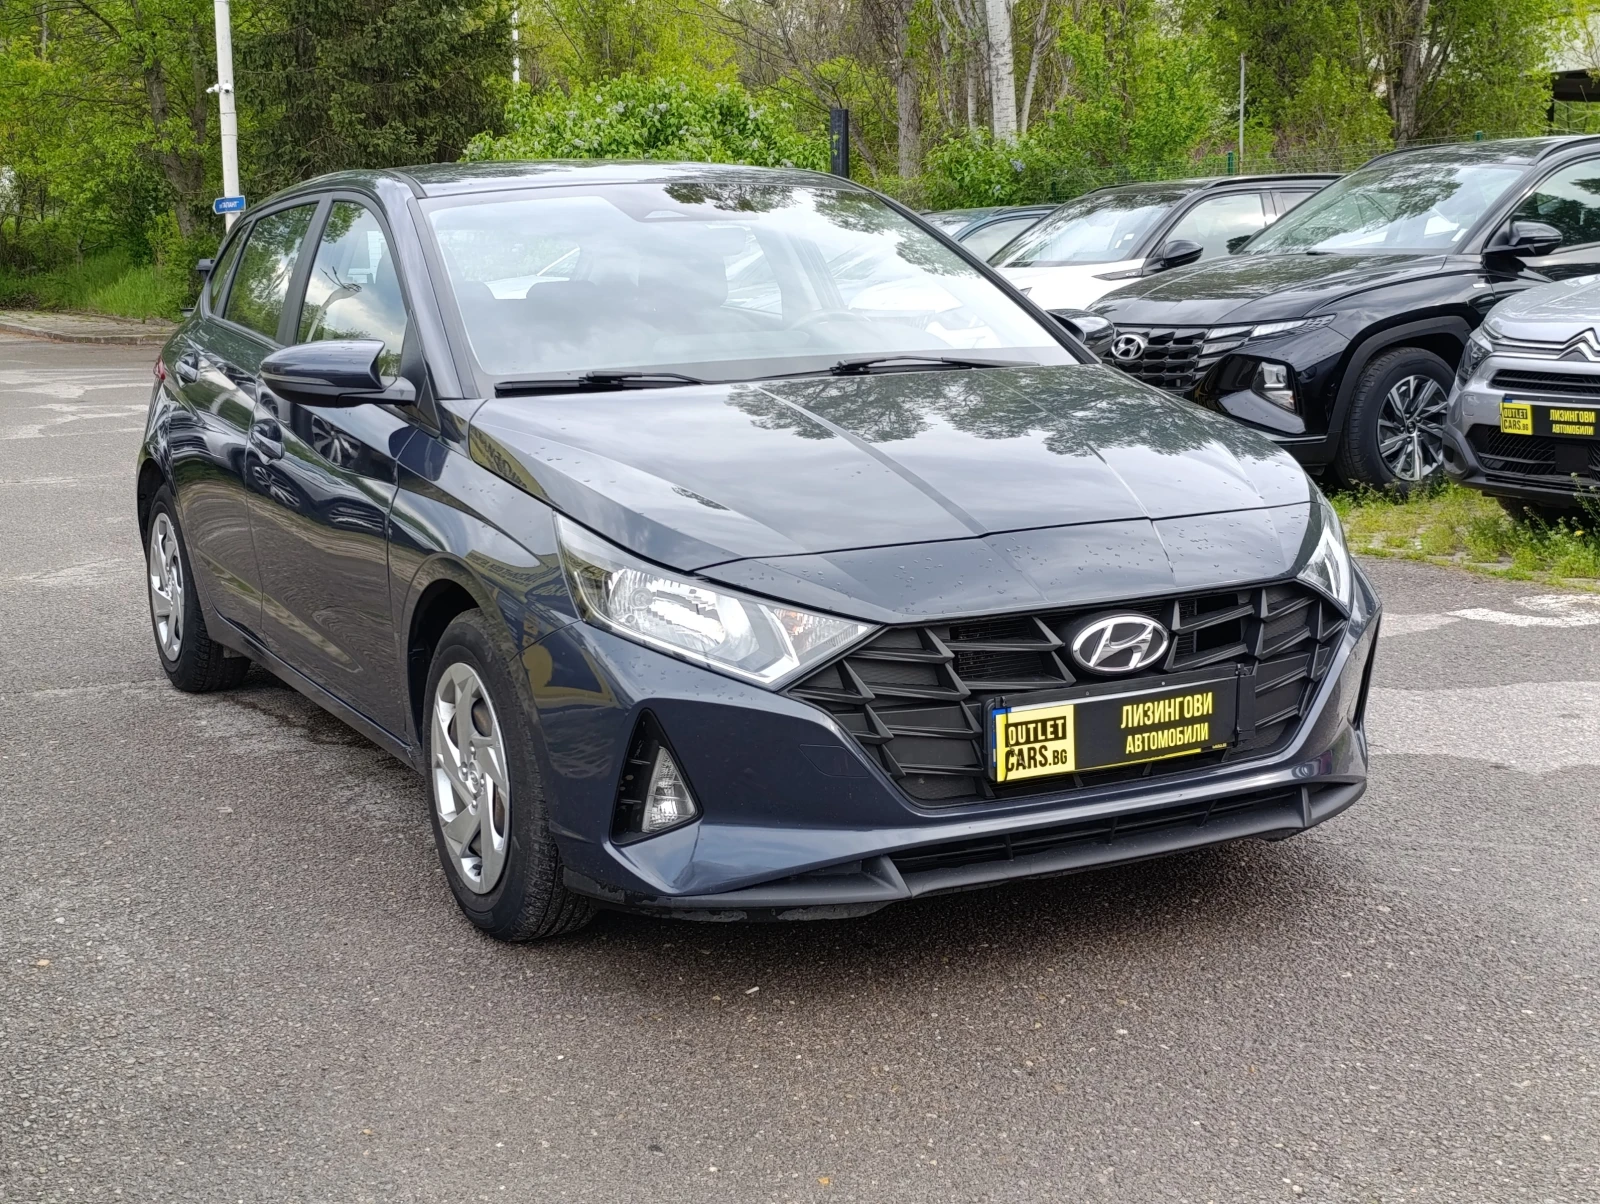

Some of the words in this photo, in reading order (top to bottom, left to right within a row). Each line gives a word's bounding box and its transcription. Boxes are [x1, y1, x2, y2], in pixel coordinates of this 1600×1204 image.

[1503, 408, 1527, 419] OUTLET
[1549, 409, 1596, 423] ЛИЗИНГОВИ
[1552, 423, 1594, 436] АВТОМОБИЛИ
[1120, 691, 1213, 729] ЛИЗИНГОВИ
[1008, 719, 1065, 745] OUTLET
[1125, 722, 1209, 754] АВТОМОБИЛИ
[1005, 744, 1068, 772] CARS.BG
